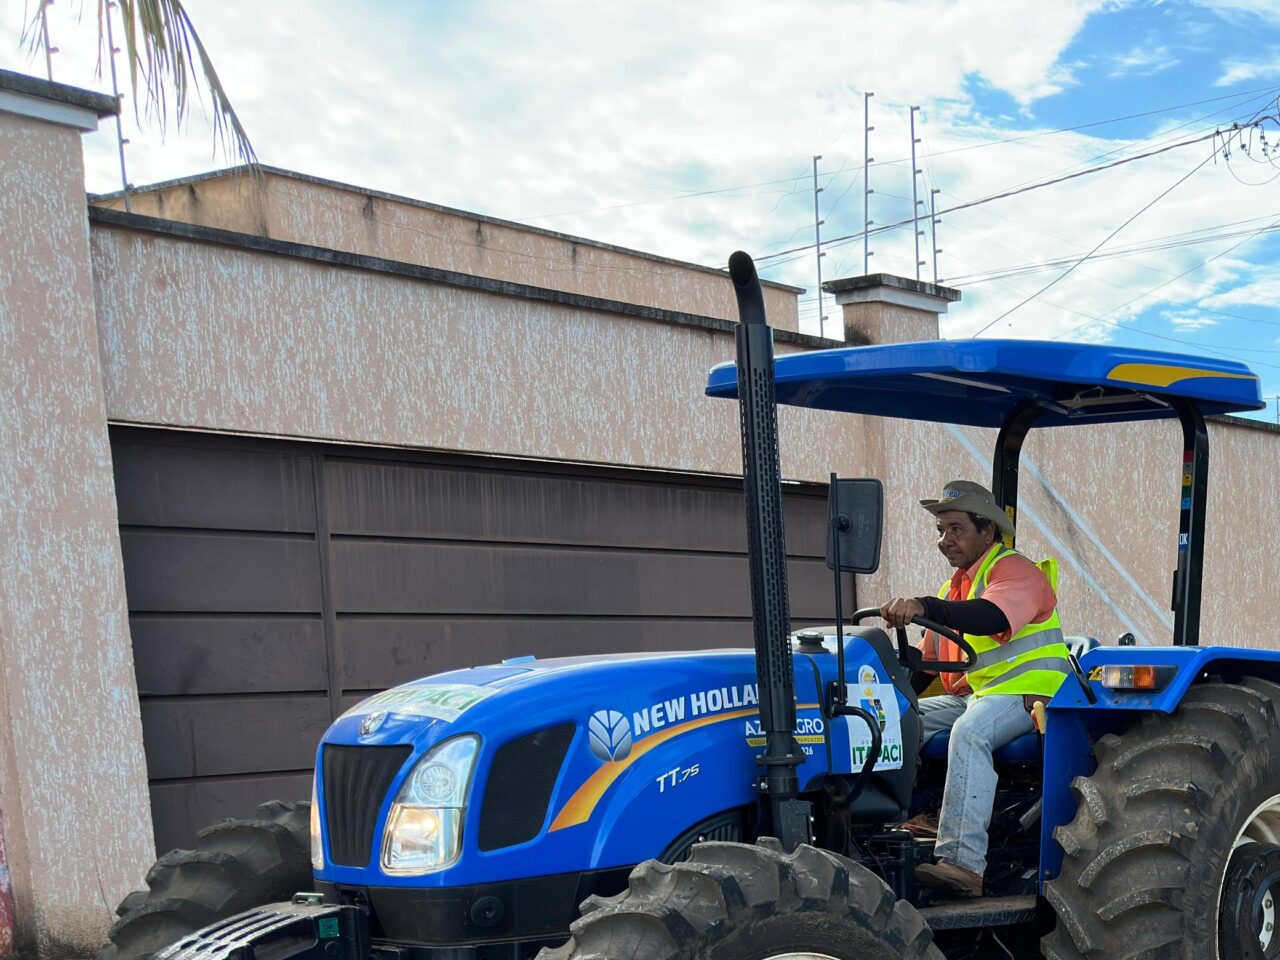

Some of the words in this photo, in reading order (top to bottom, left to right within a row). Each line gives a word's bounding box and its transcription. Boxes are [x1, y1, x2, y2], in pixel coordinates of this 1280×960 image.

[633, 696, 685, 736] NEW
[690, 683, 760, 716] HOLLA
[852, 744, 902, 765] ITAACI
